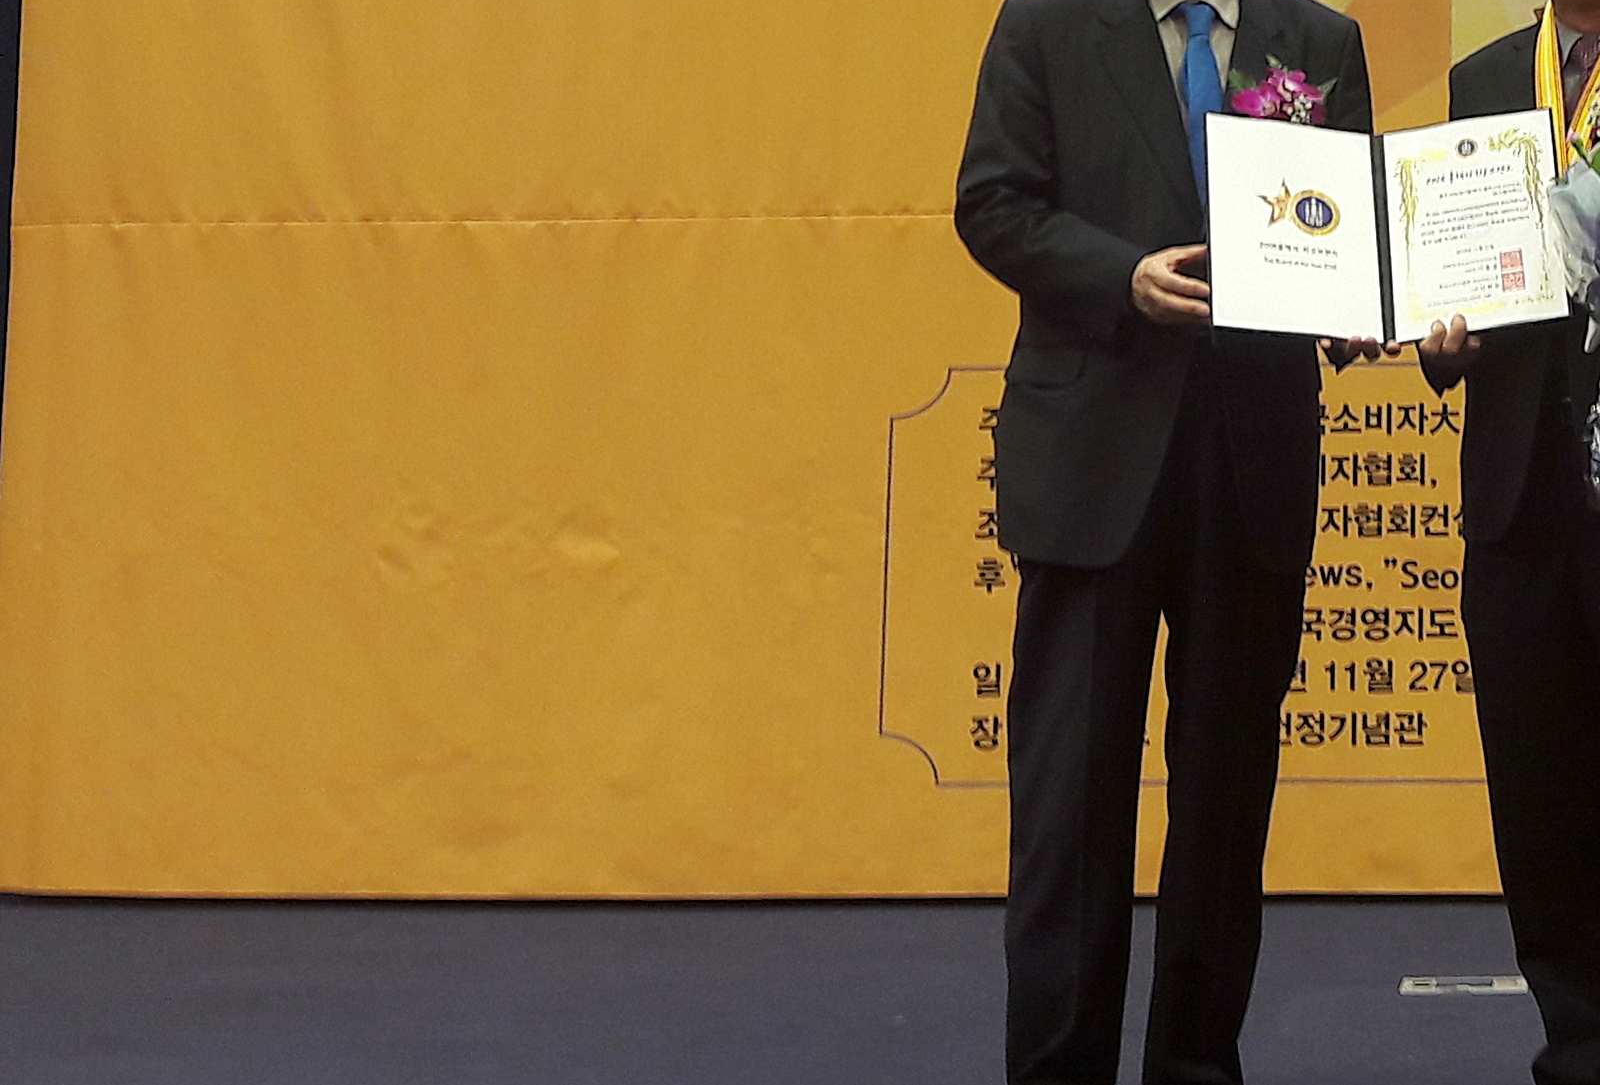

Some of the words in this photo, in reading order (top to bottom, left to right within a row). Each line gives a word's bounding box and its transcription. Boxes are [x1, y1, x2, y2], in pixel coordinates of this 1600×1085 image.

[973, 556, 1006, 593] 후
[973, 661, 1001, 698] 일
[1325, 658, 1394, 694] 11월
[970, 716, 1003, 752] 장
